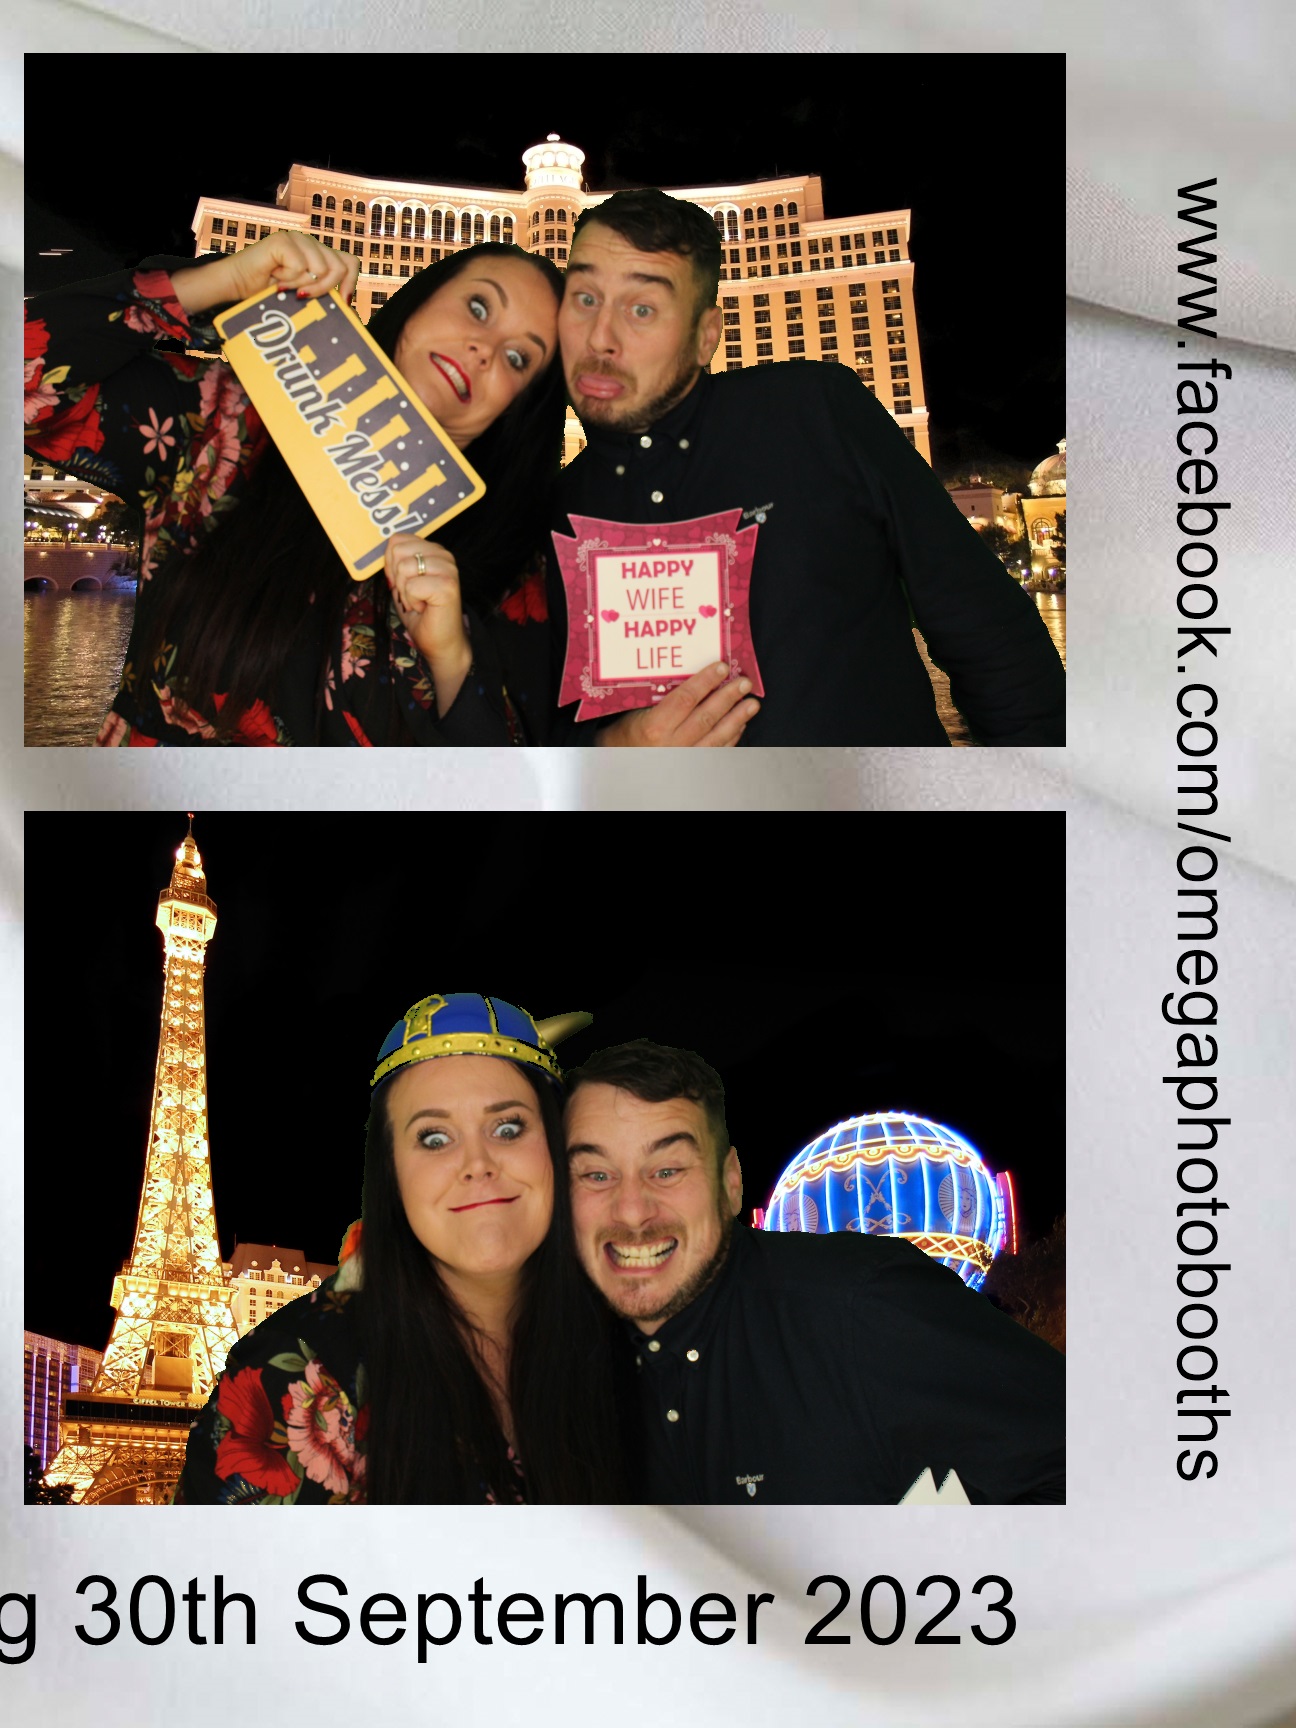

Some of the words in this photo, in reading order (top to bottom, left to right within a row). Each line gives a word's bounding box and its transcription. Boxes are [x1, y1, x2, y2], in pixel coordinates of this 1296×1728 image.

[244, 309, 347, 438] Drunk
[324, 430, 424, 538] Mess!
[621, 560, 694, 579] HAPPY
[626, 587, 685, 610] WIFE
[624, 619, 696, 638] HAPPY
[637, 646, 682, 669] LIFE
